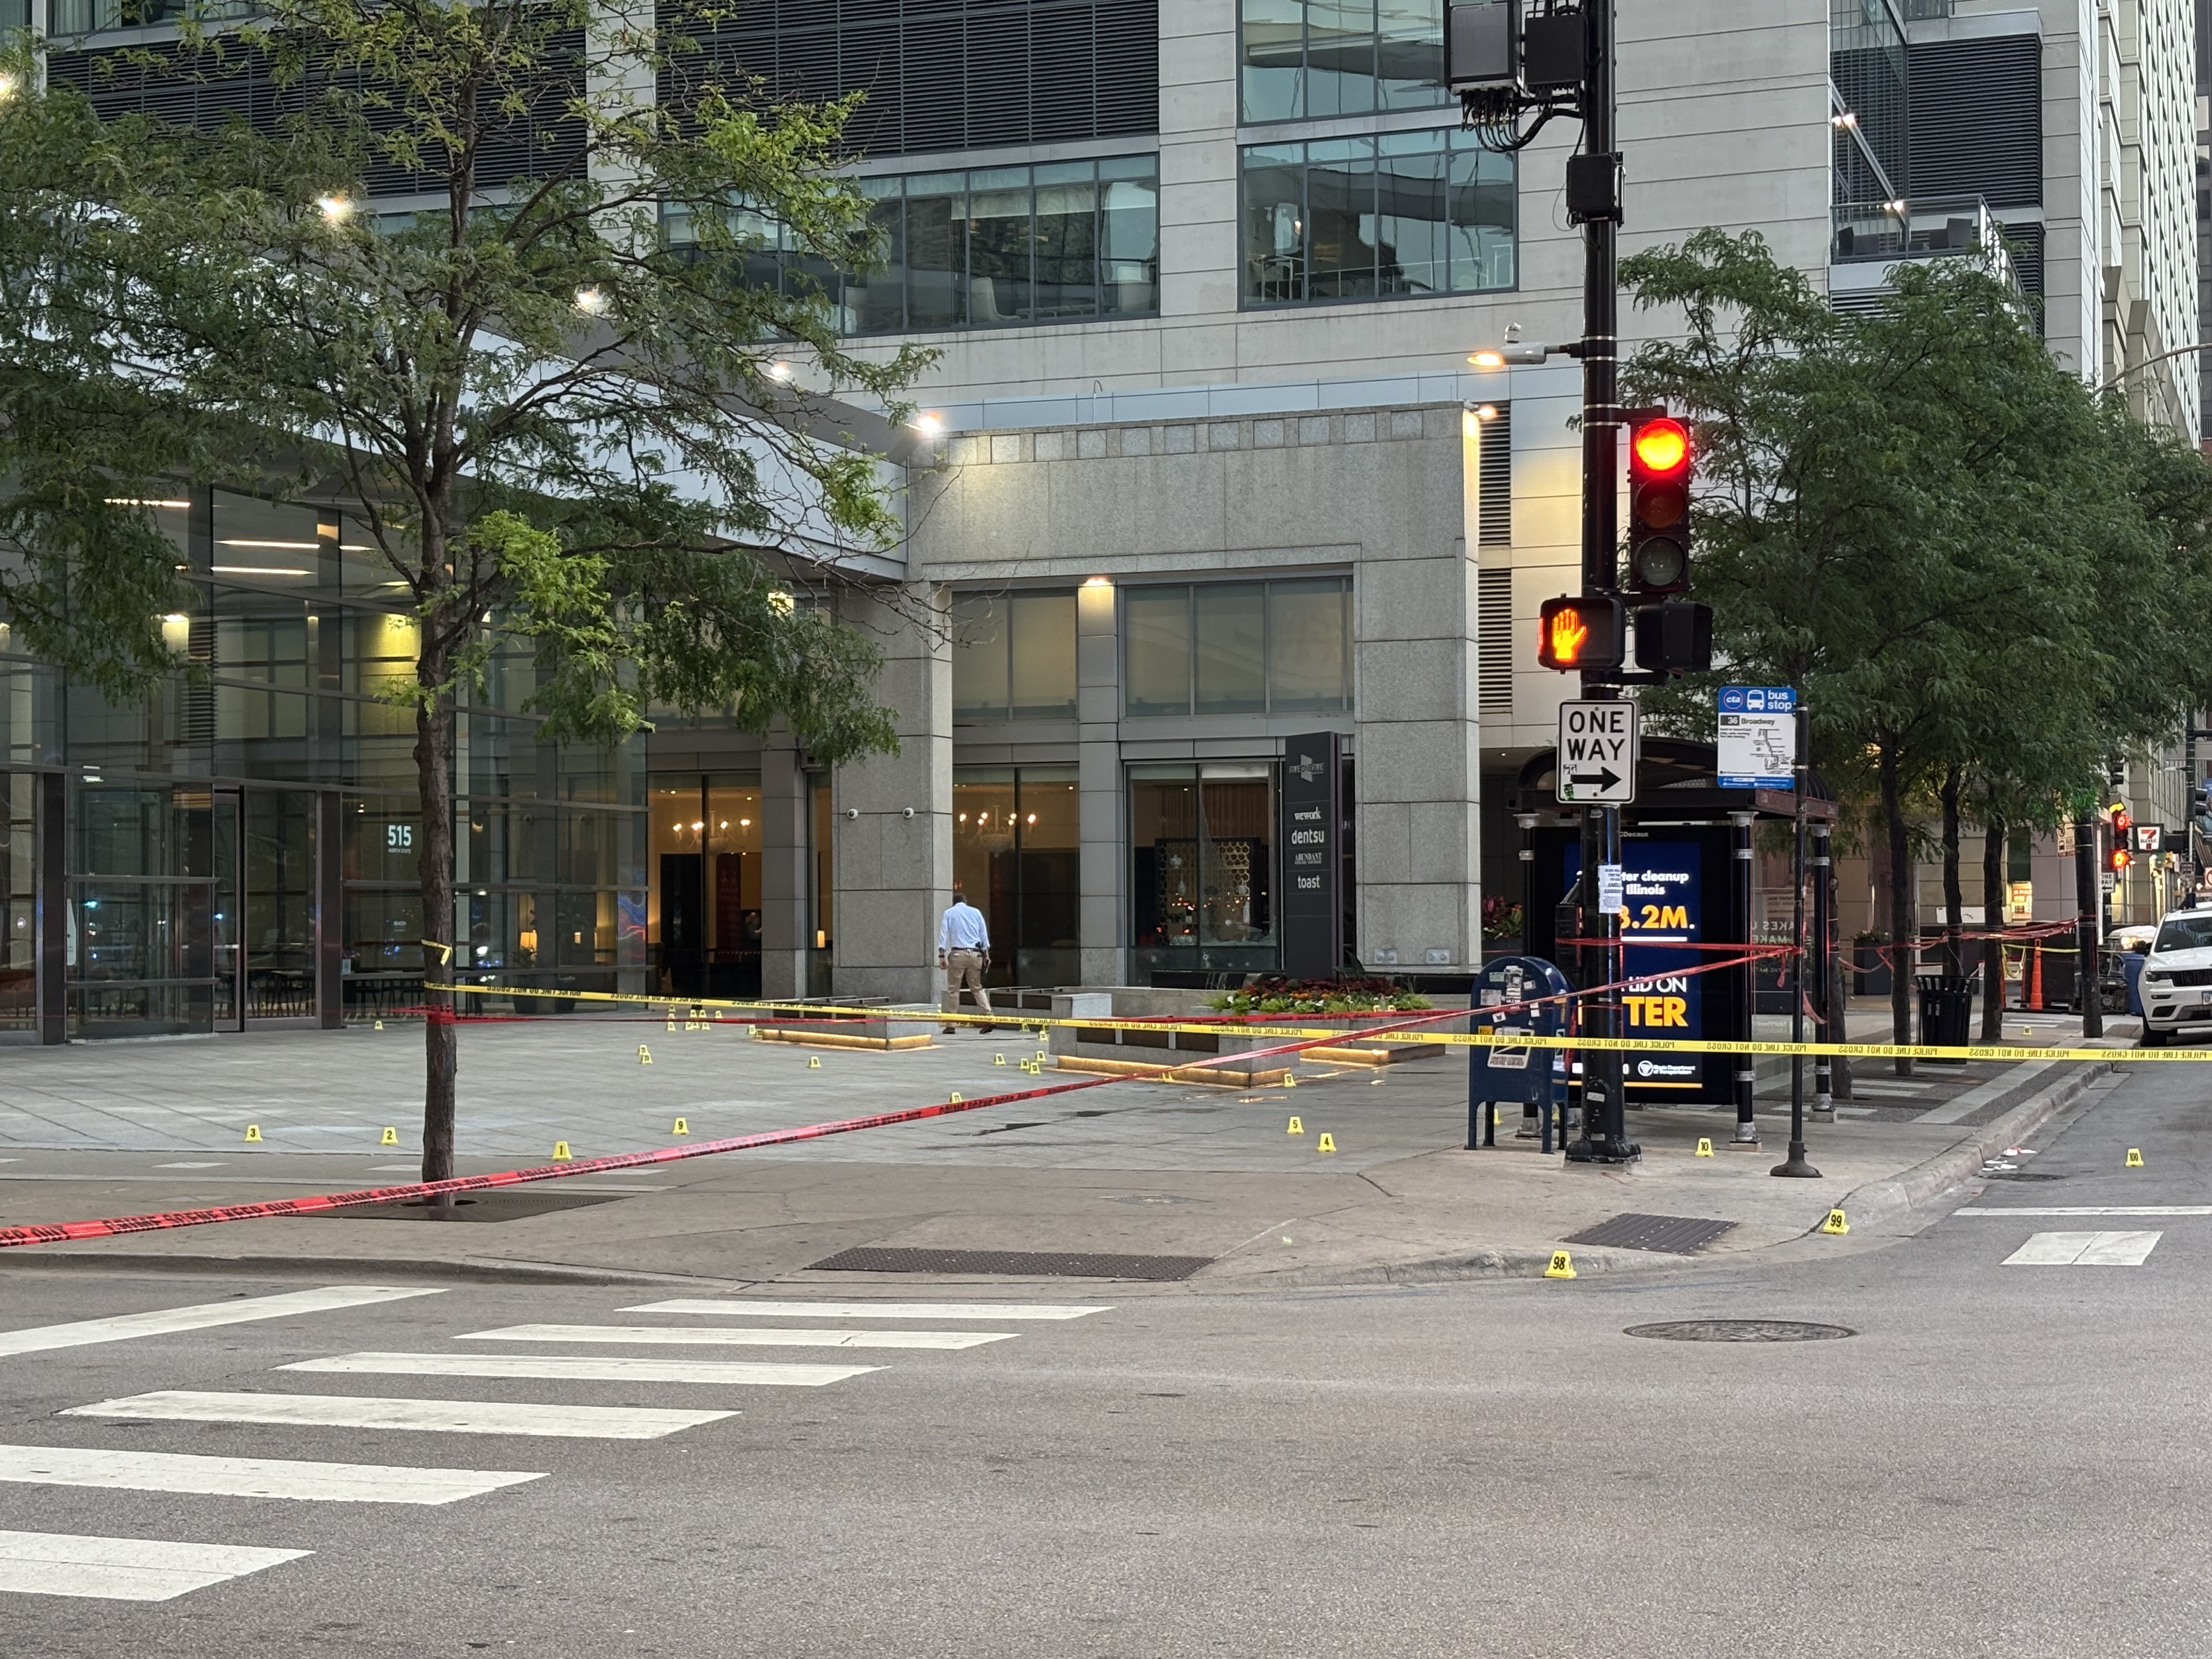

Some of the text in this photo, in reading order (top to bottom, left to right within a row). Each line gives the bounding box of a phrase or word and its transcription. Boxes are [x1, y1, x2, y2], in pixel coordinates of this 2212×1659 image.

[1768, 690, 1788, 700] bus
[1767, 702, 1792, 712] stop
[1569, 710, 1624, 733] ONE
[1741, 718, 1775, 726] Broadway
[1567, 738, 1625, 761] WAY
[1294, 806, 1321, 821] wework
[388, 825, 411, 847] 515
[1291, 829, 1324, 844] dentsu
[1294, 853, 1322, 861] ABUNDANT
[1297, 875, 1321, 889] toast
[1641, 870, 1690, 884] cleanup
[1626, 884, 1666, 895] Illinois
[678, 1120, 683, 1130] 9
[1293, 1120, 1298, 1129] 5
[250, 1128, 256, 1137] 3
[386, 1130, 392, 1139] 2
[1324, 1137, 1329, 1146] 4
[1701, 1142, 1709, 1151] 10
[559, 1145, 563, 1155] 1
[2129, 1152, 2139, 1162] 100
[1830, 1214, 1843, 1228] 99
[1553, 1256, 1566, 1270] 98
